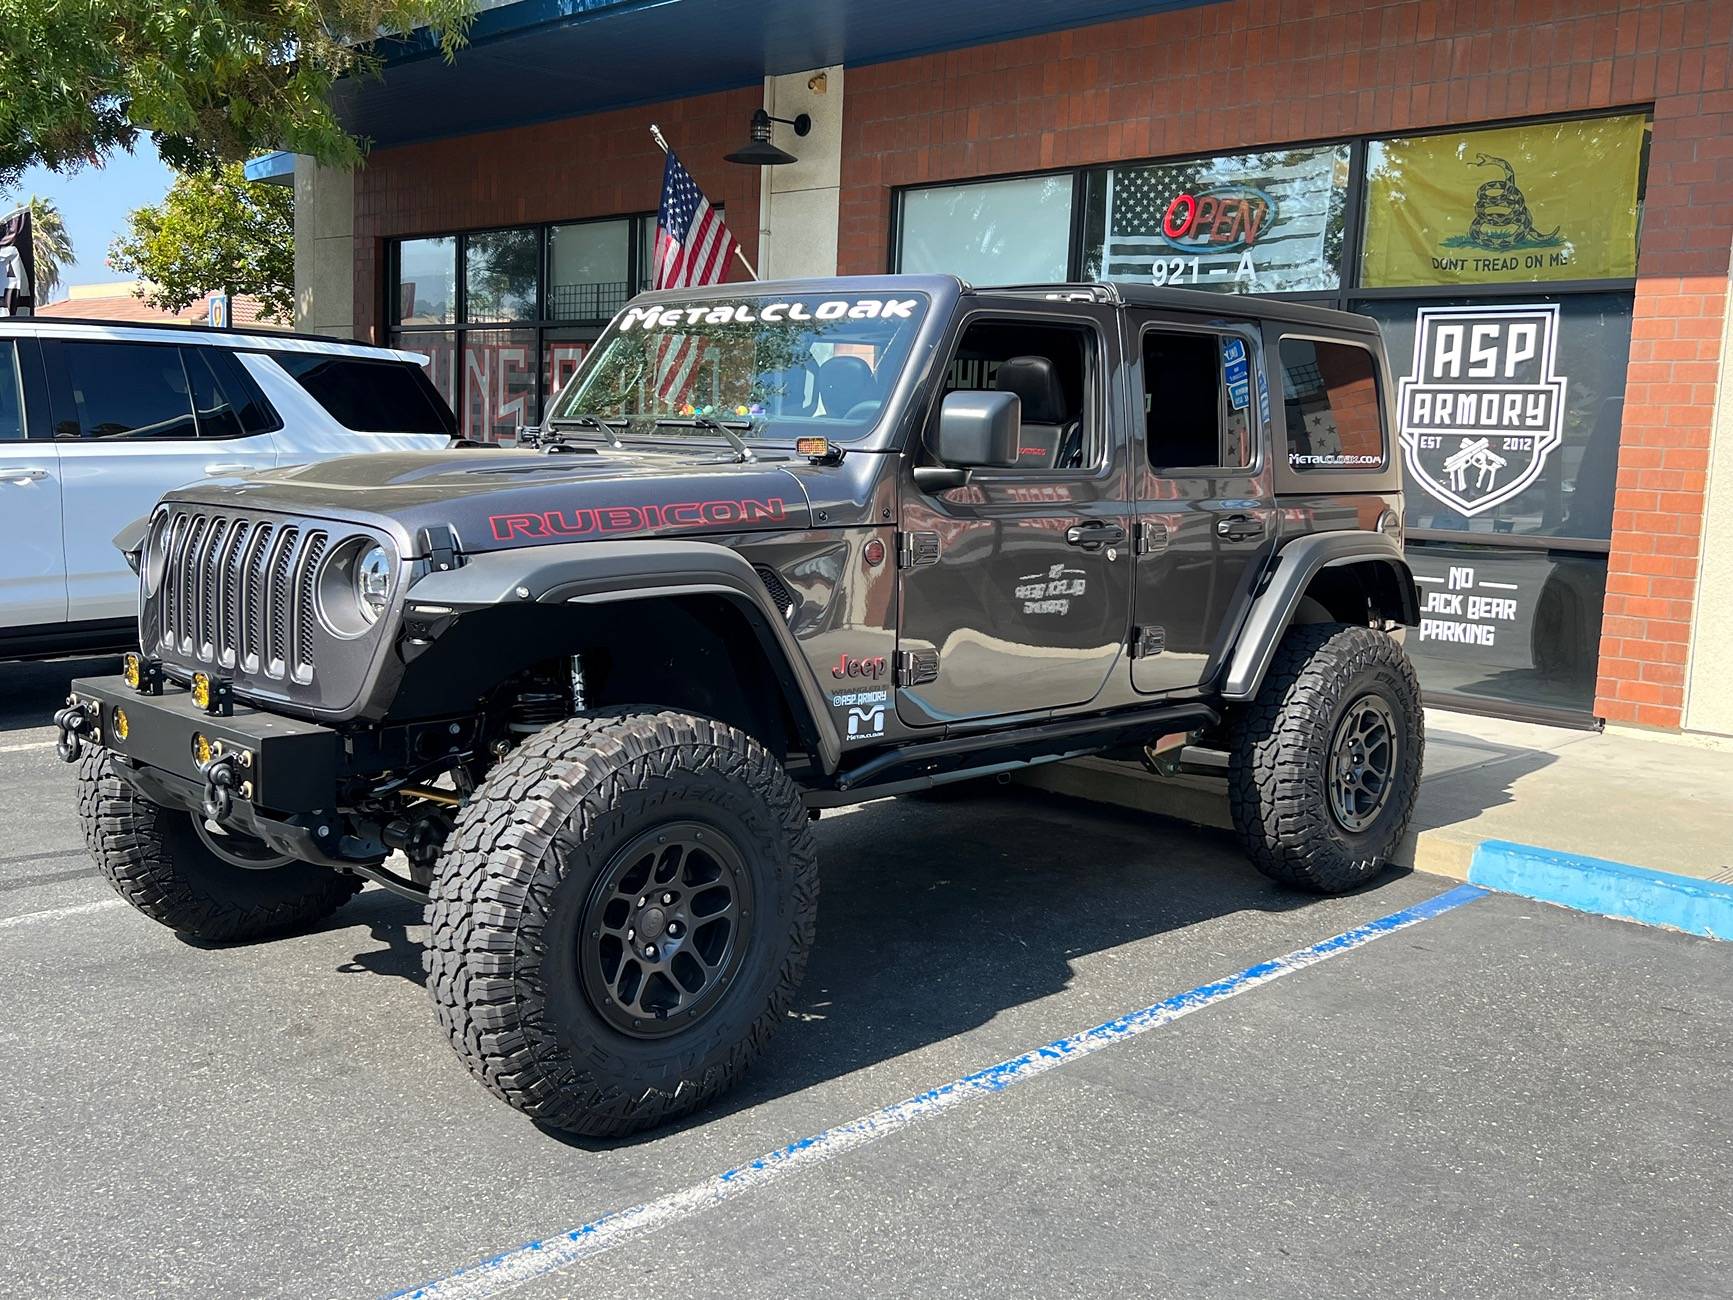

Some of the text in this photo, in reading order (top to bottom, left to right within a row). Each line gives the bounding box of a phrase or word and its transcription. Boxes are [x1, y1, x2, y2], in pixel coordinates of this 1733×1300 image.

[1163, 194, 1267, 247] OPEN
[1152, 256, 1199, 287] 921
[1234, 249, 1257, 282] A
[1432, 257, 1468, 271] DONT
[1473, 257, 1519, 272] TREAD
[1525, 254, 1543, 269] ON
[619, 300, 918, 331] METALCLOAK
[1433, 323, 1537, 378] ASP
[1412, 393, 1546, 426] ARMORY
[1420, 436, 1532, 450] EST 2012
[1288, 453, 1382, 465] METALCLOAK.COM
[489, 498, 785, 540] RUBICON
[1448, 566, 1475, 590] NO
[1420, 592, 1517, 620] ACK BEAR
[1419, 618, 1496, 646] PARKING
[832, 653, 887, 681] Jeep
